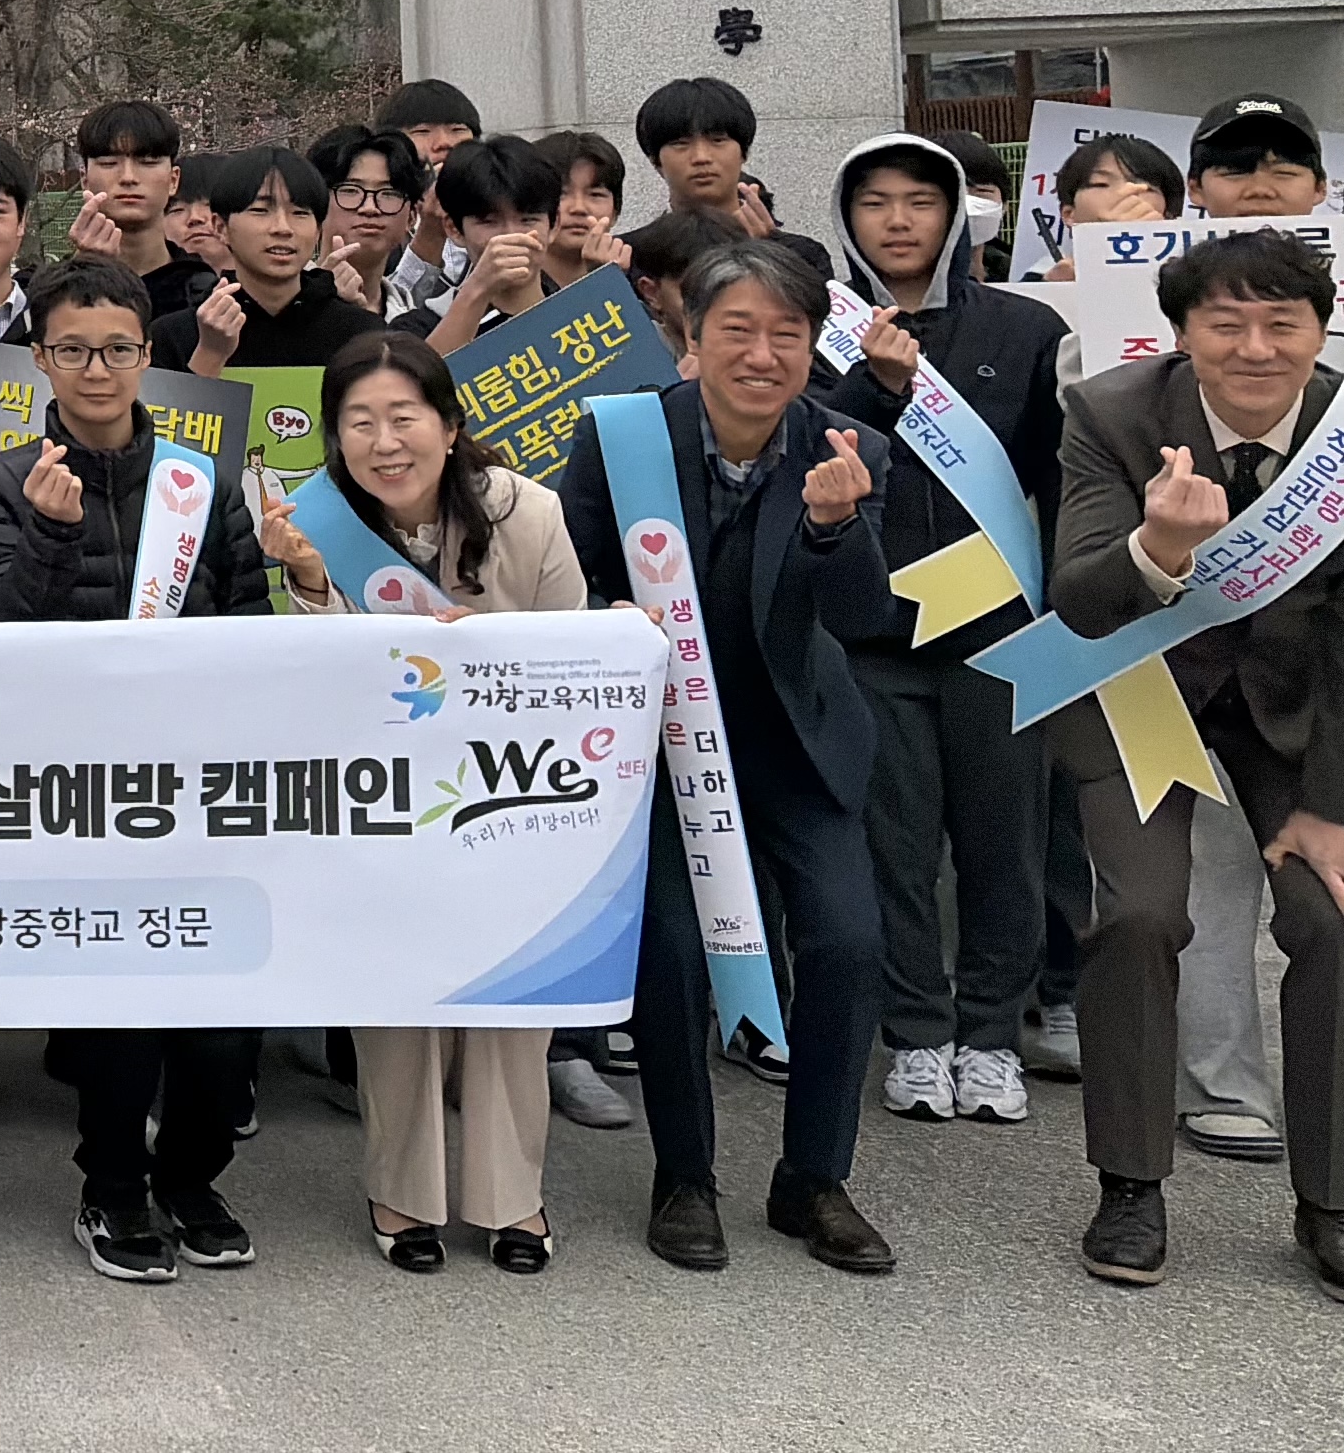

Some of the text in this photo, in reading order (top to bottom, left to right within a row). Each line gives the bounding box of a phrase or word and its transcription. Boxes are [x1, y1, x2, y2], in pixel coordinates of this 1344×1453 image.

[551, 300, 631, 364] 장난
[1219, 523, 1323, 603] 학교사랑
[461, 662, 524, 678] 경상남도
[670, 599, 709, 701] 생명은
[462, 680, 647, 713] 거창교육지원청
[200, 755, 413, 839] 캠페인
[617, 759, 647, 779] 센터
[694, 730, 735, 833] 더하고
[463, 808, 601, 850] 우리가 희망이다!
[675, 774, 713, 878] 나누고
[137, 906, 212, 950] 정문
